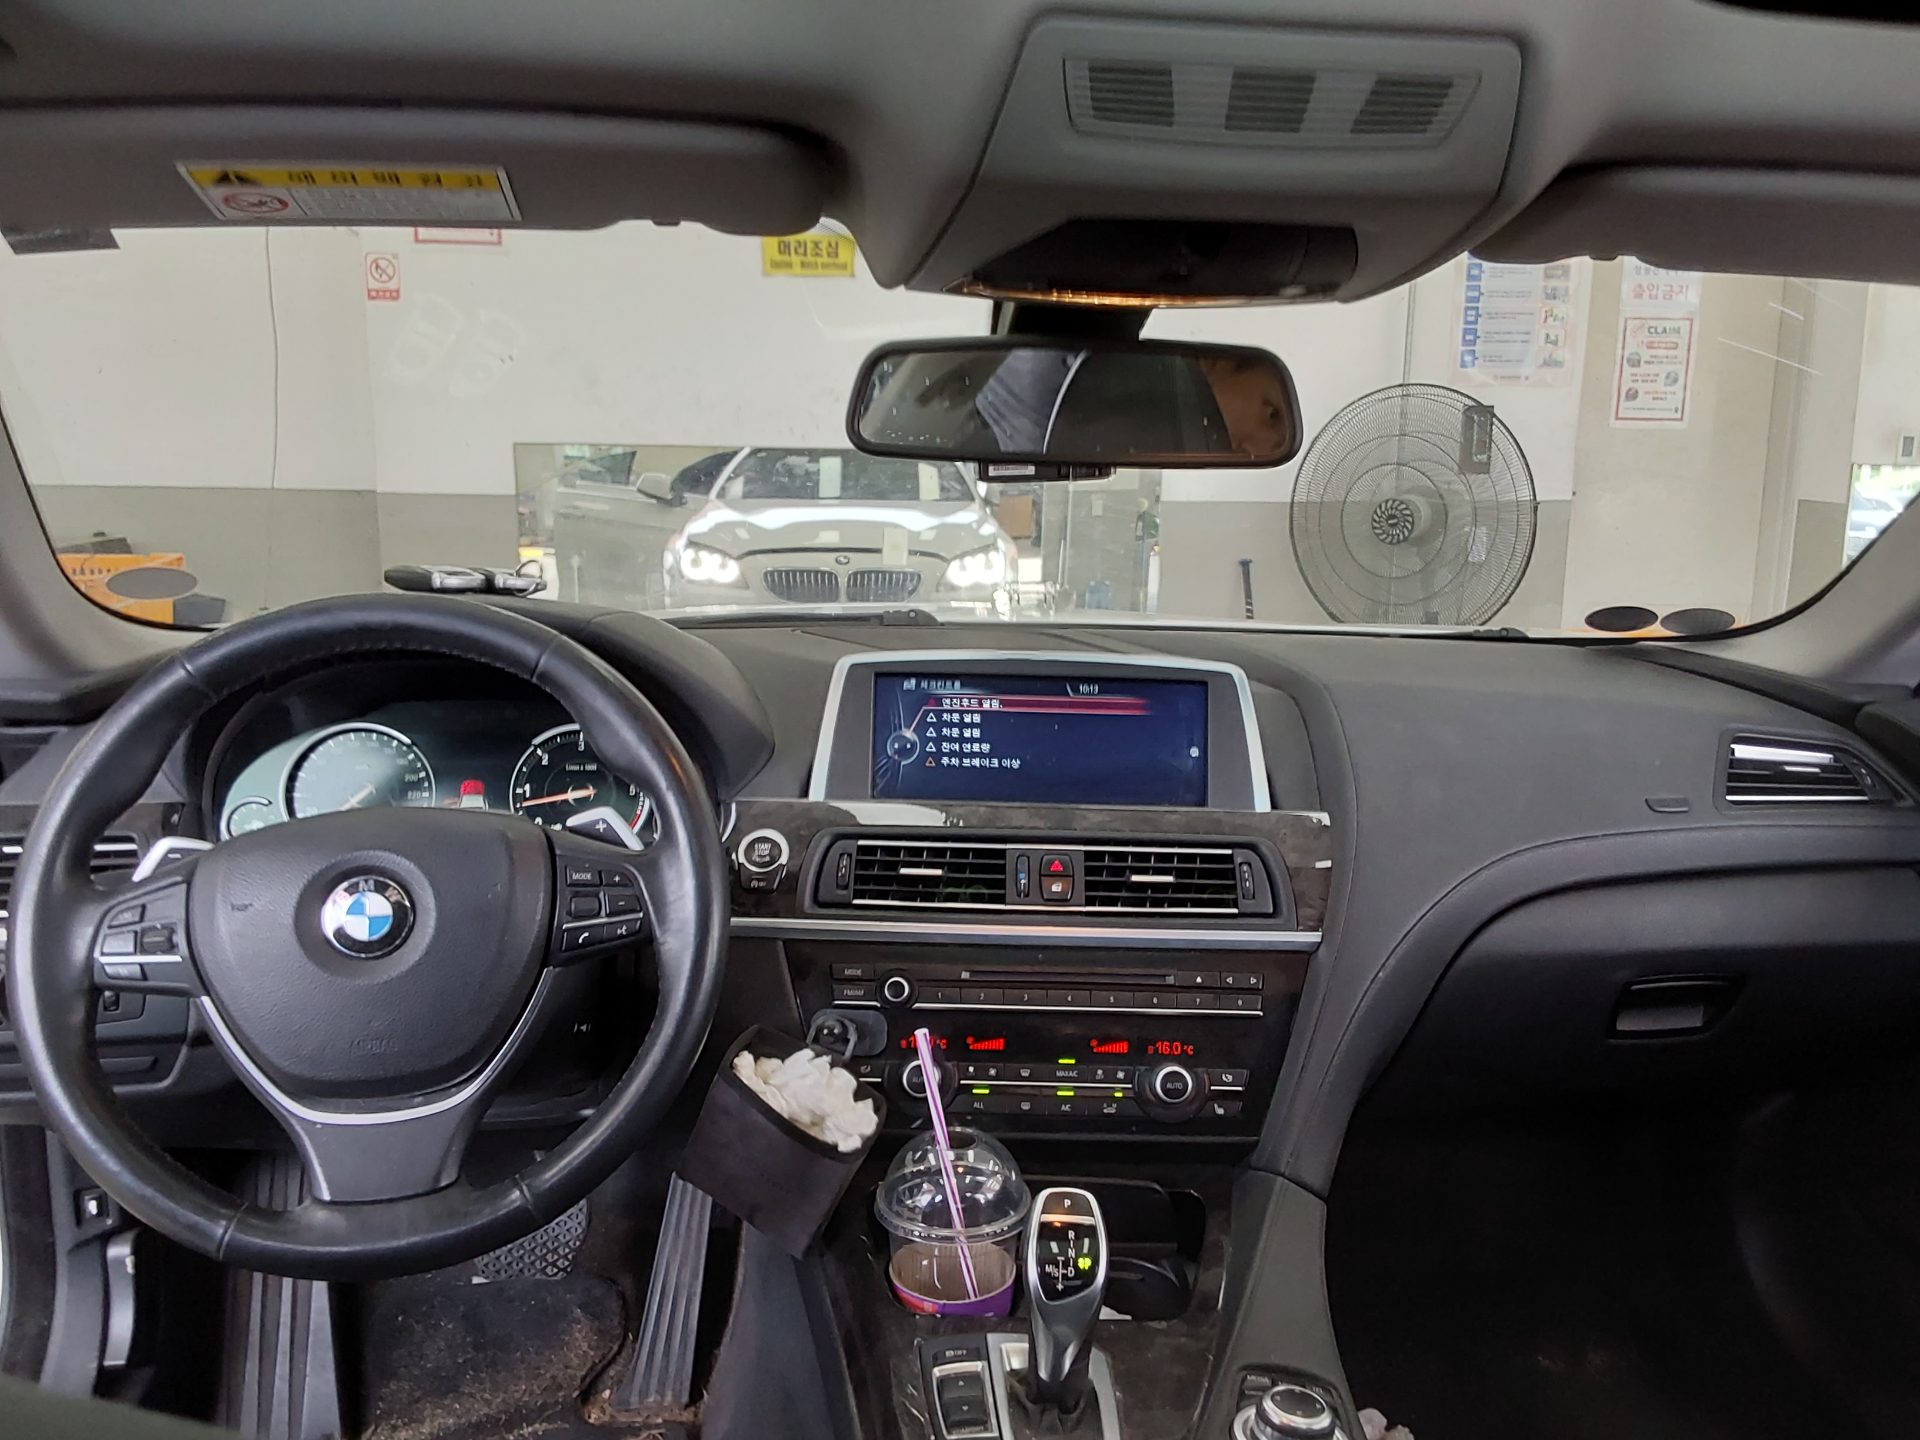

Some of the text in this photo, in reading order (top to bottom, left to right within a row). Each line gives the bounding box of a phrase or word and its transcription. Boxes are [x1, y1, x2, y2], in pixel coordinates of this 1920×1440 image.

[778, 239, 839, 258] 머리조심
[1647, 326, 1681, 334] CLAIM
[942, 698, 979, 708] 엔진후드
[942, 713, 981, 723] 차문 열림
[941, 728, 980, 738] 차문 열림
[941, 742, 959, 752] 잔여
[542, 753, 549, 765] 2
[941, 757, 1020, 769] 주차 브레이크 이상
[523, 783, 531, 797] 1
[572, 871, 592, 881] MODE
[1155, 1042, 1181, 1055] 16.0
[1166, 1082, 1183, 1090] AUTO
[1064, 1199, 1071, 1208] P
[1068, 1230, 1075, 1240] R
[1068, 1248, 1075, 1258] N
[1045, 1264, 1059, 1277] M/S
[1068, 1267, 1075, 1277] D
